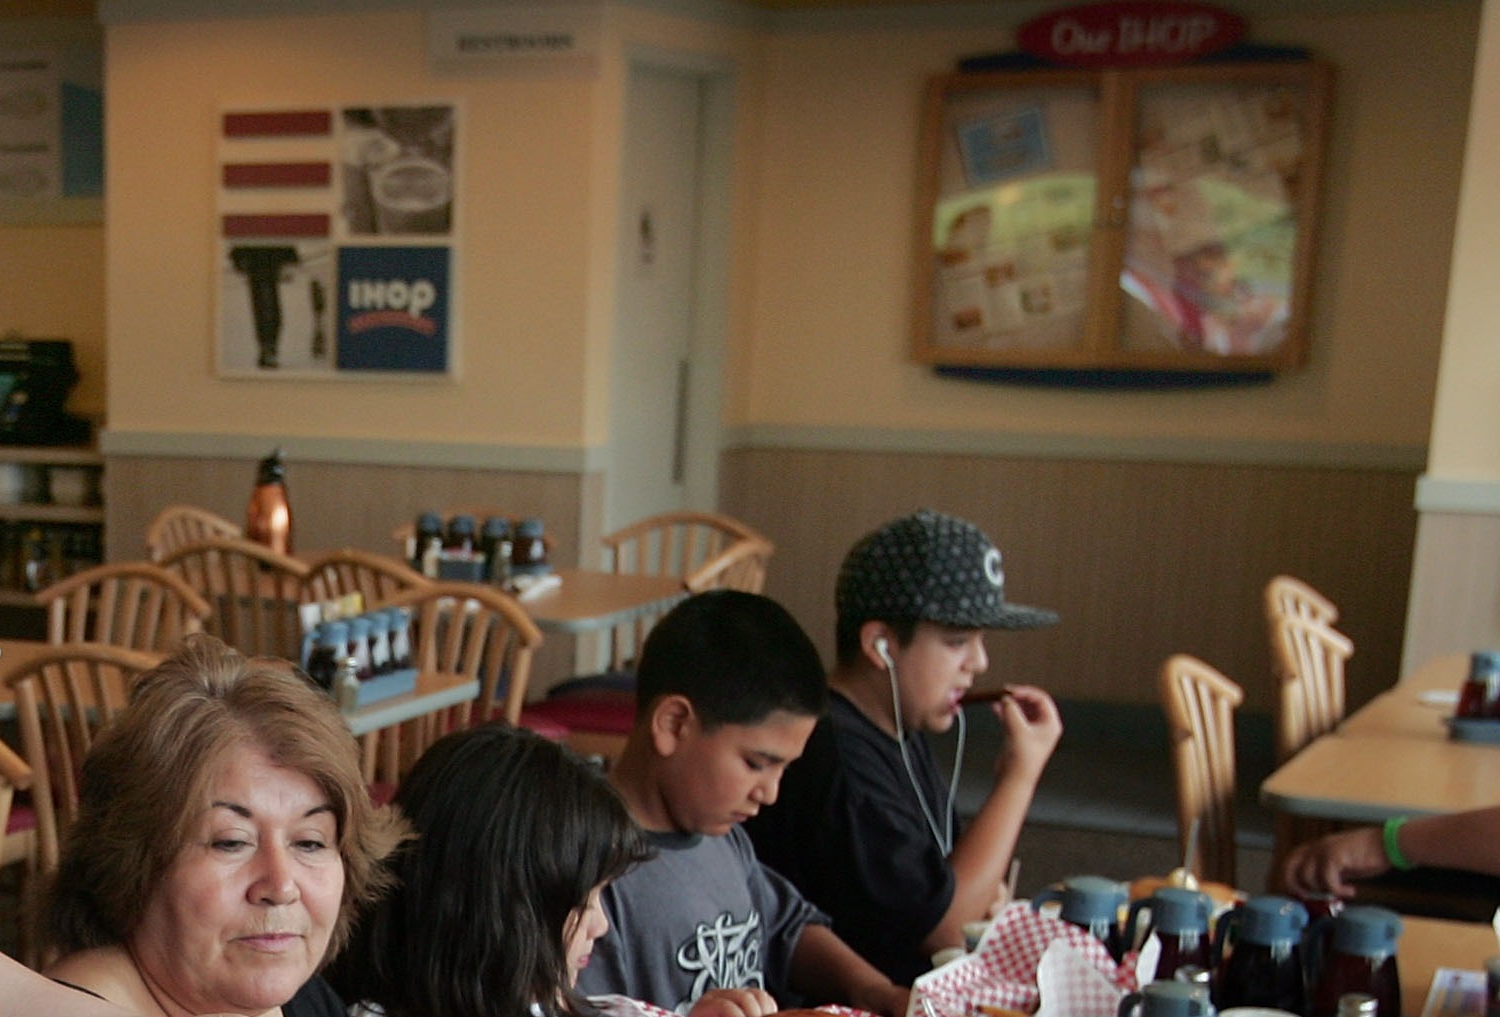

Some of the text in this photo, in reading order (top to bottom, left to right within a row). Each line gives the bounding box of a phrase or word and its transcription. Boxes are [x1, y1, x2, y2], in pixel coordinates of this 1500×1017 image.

[1051, 15, 1216, 54] Our IHOP
[347, 279, 436, 319] IHOP
